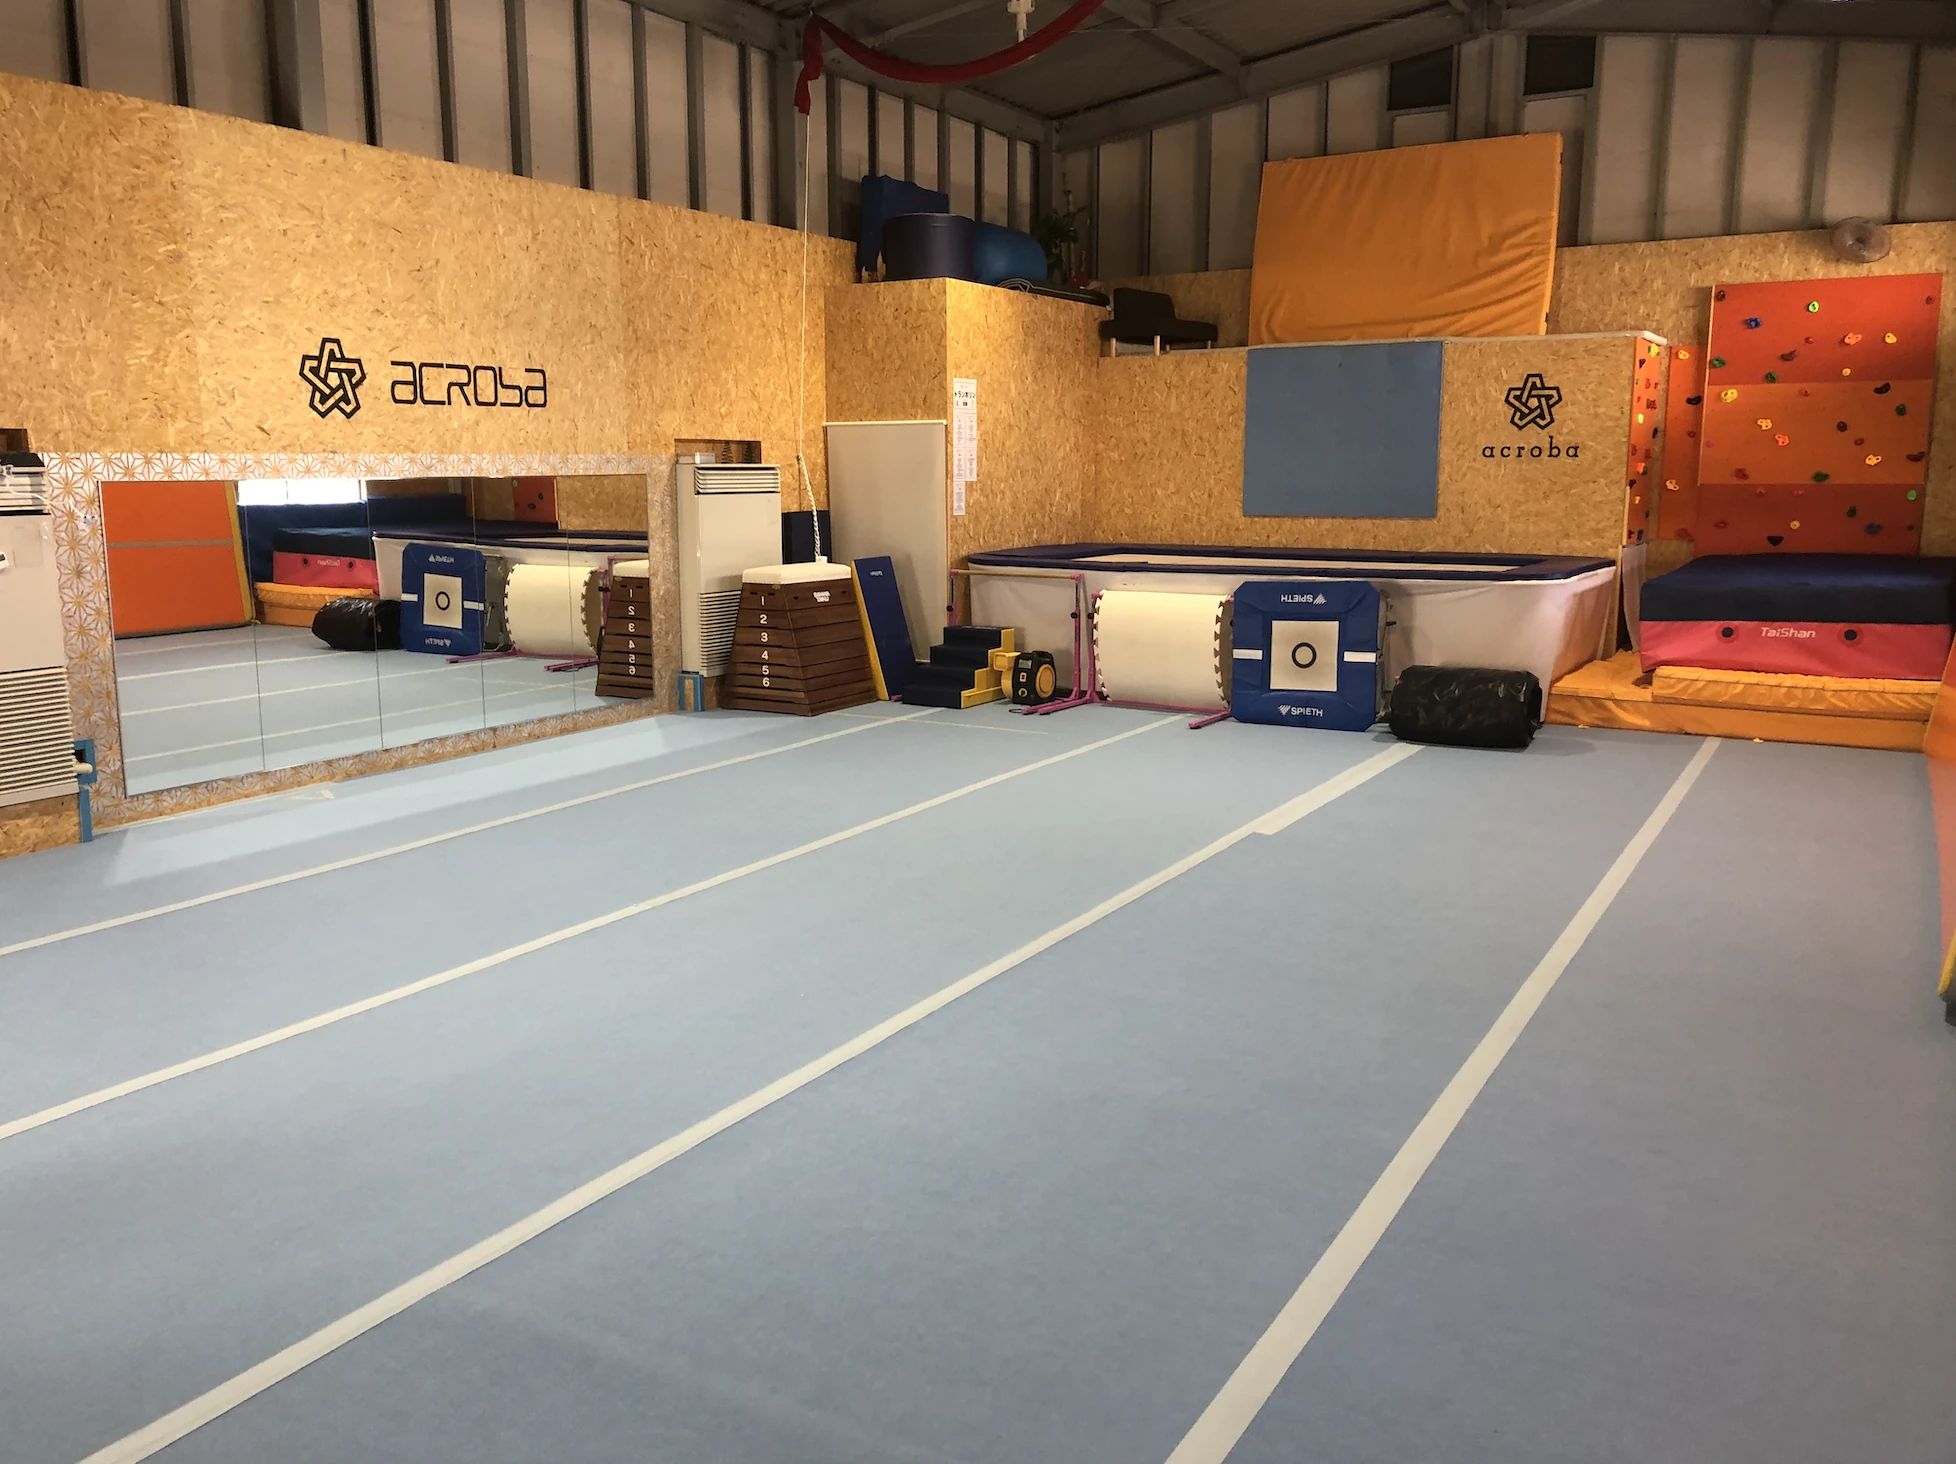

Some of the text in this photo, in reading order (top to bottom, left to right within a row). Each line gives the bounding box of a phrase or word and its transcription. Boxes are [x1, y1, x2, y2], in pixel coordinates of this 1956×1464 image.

[1482, 435, 1579, 458] acroba
[1281, 594, 1314, 603] SPIETH
[759, 614, 768, 624] 2
[760, 632, 769, 643] 3
[1761, 626, 1817, 639] TaiShan
[761, 651, 769, 660] 4
[762, 666, 770, 675] 5
[762, 678, 770, 687] 6
[1290, 707, 1324, 717] SPIETH
